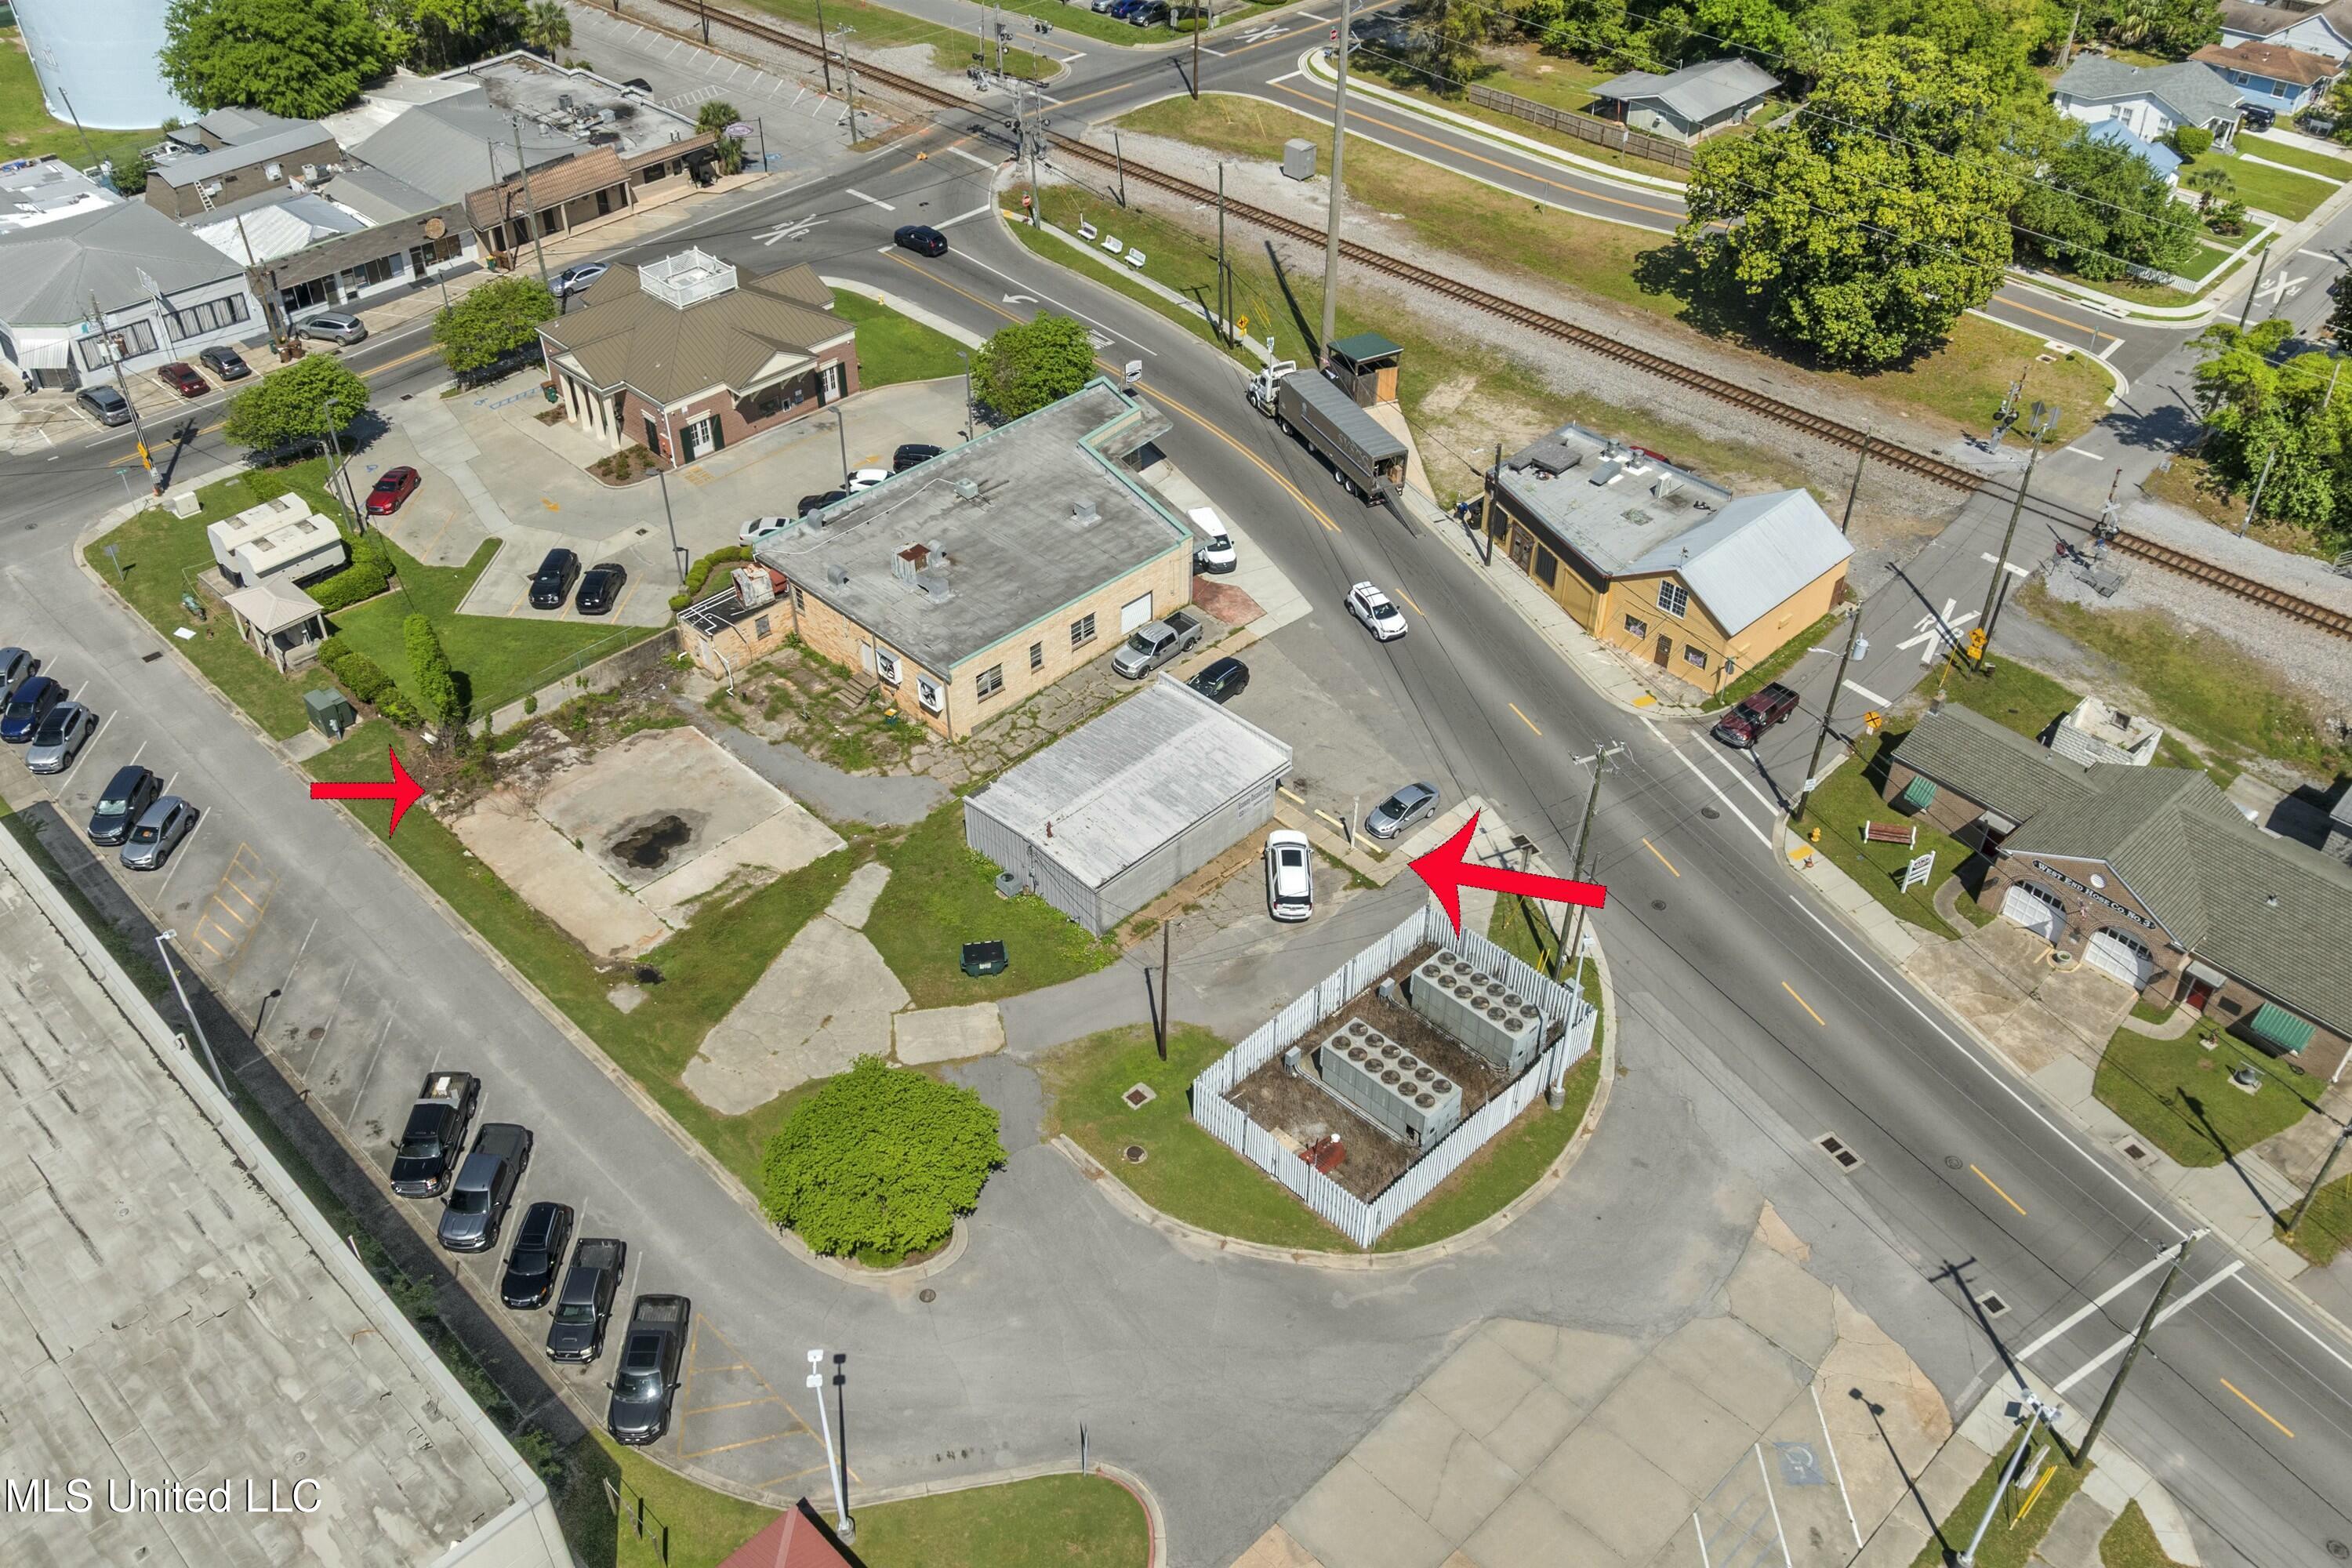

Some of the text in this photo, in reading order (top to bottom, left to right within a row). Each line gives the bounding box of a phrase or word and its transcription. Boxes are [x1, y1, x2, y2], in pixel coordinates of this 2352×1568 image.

[2038, 863, 2063, 880] WEST
[2064, 877, 2083, 891] END
[2085, 889, 2110, 906] HOSE
[2143, 919, 2151, 927] 3
